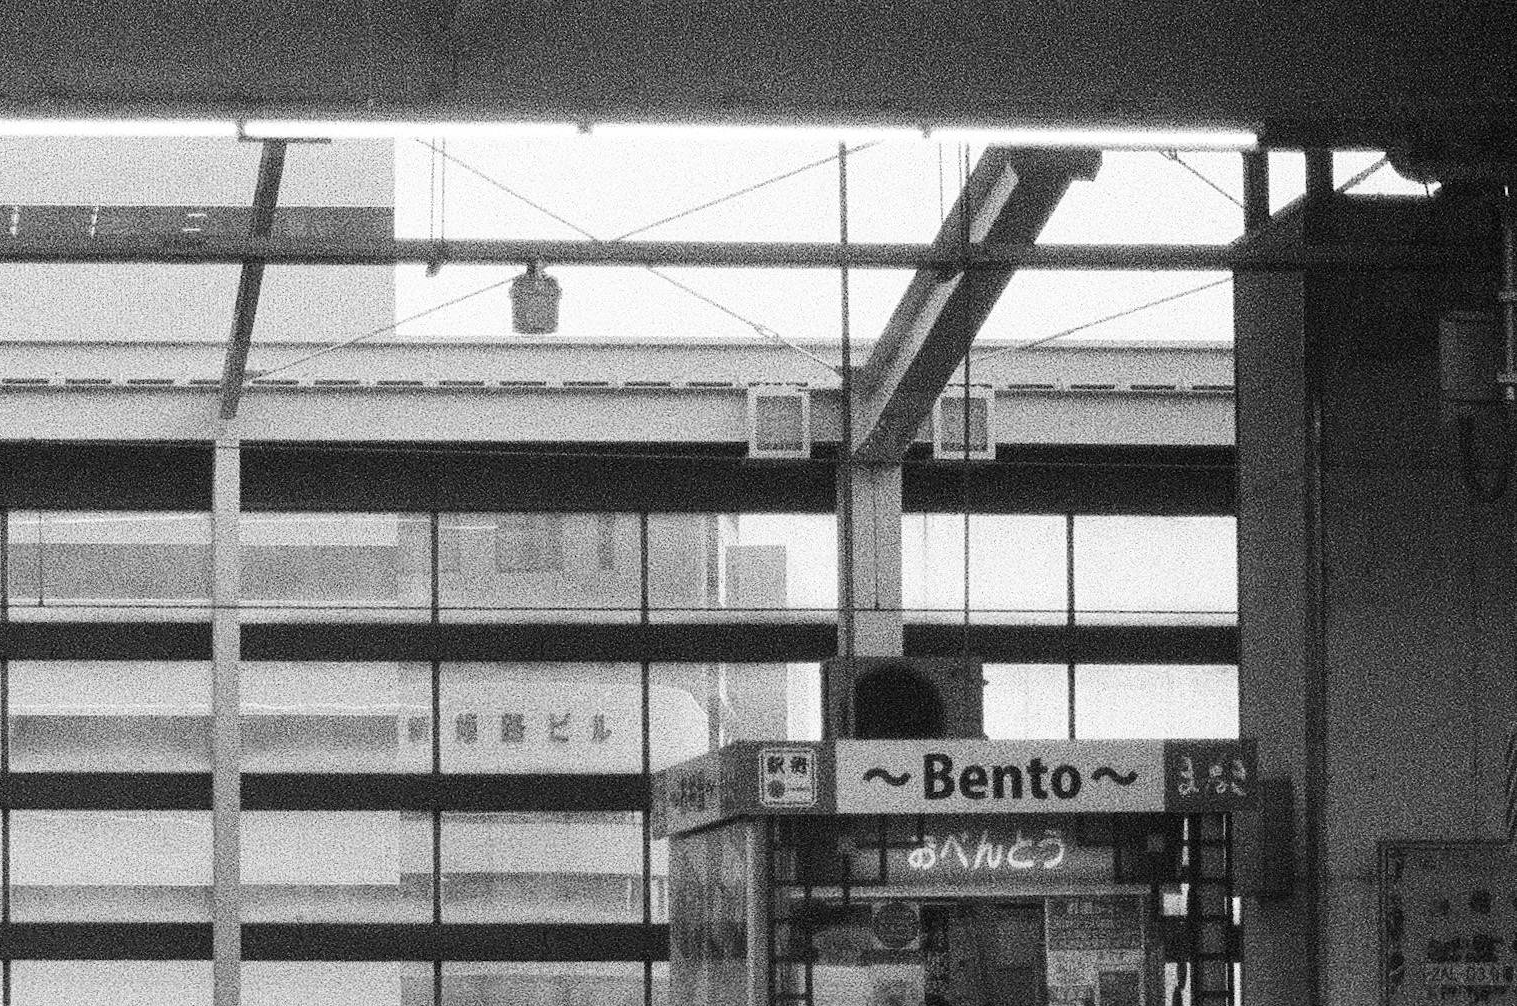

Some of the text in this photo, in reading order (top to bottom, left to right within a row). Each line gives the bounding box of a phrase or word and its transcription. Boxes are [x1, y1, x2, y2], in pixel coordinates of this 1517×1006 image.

[907, 829, 1066, 870] おべんとう
